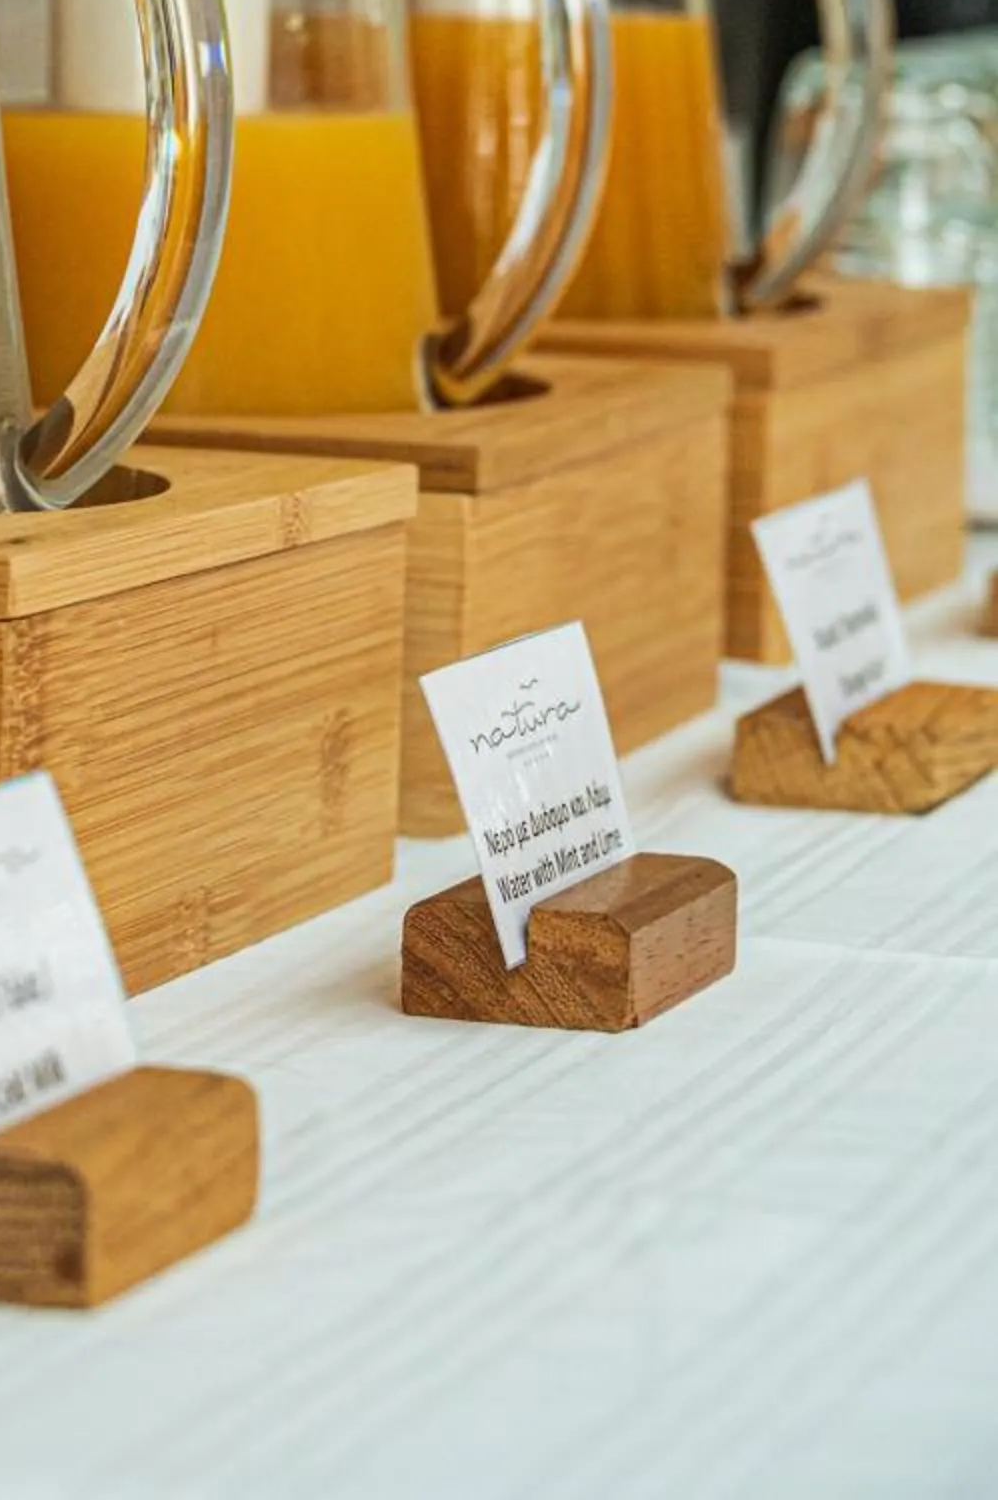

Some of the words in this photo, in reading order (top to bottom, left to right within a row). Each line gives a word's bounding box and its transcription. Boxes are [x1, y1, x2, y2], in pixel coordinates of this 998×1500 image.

[470, 700, 581, 753] natura
[483, 820, 515, 857] Νερό
[495, 871, 533, 903] Water
[531, 853, 557, 887] with
[553, 845, 581, 876] Mint
[579, 831, 600, 865] and
